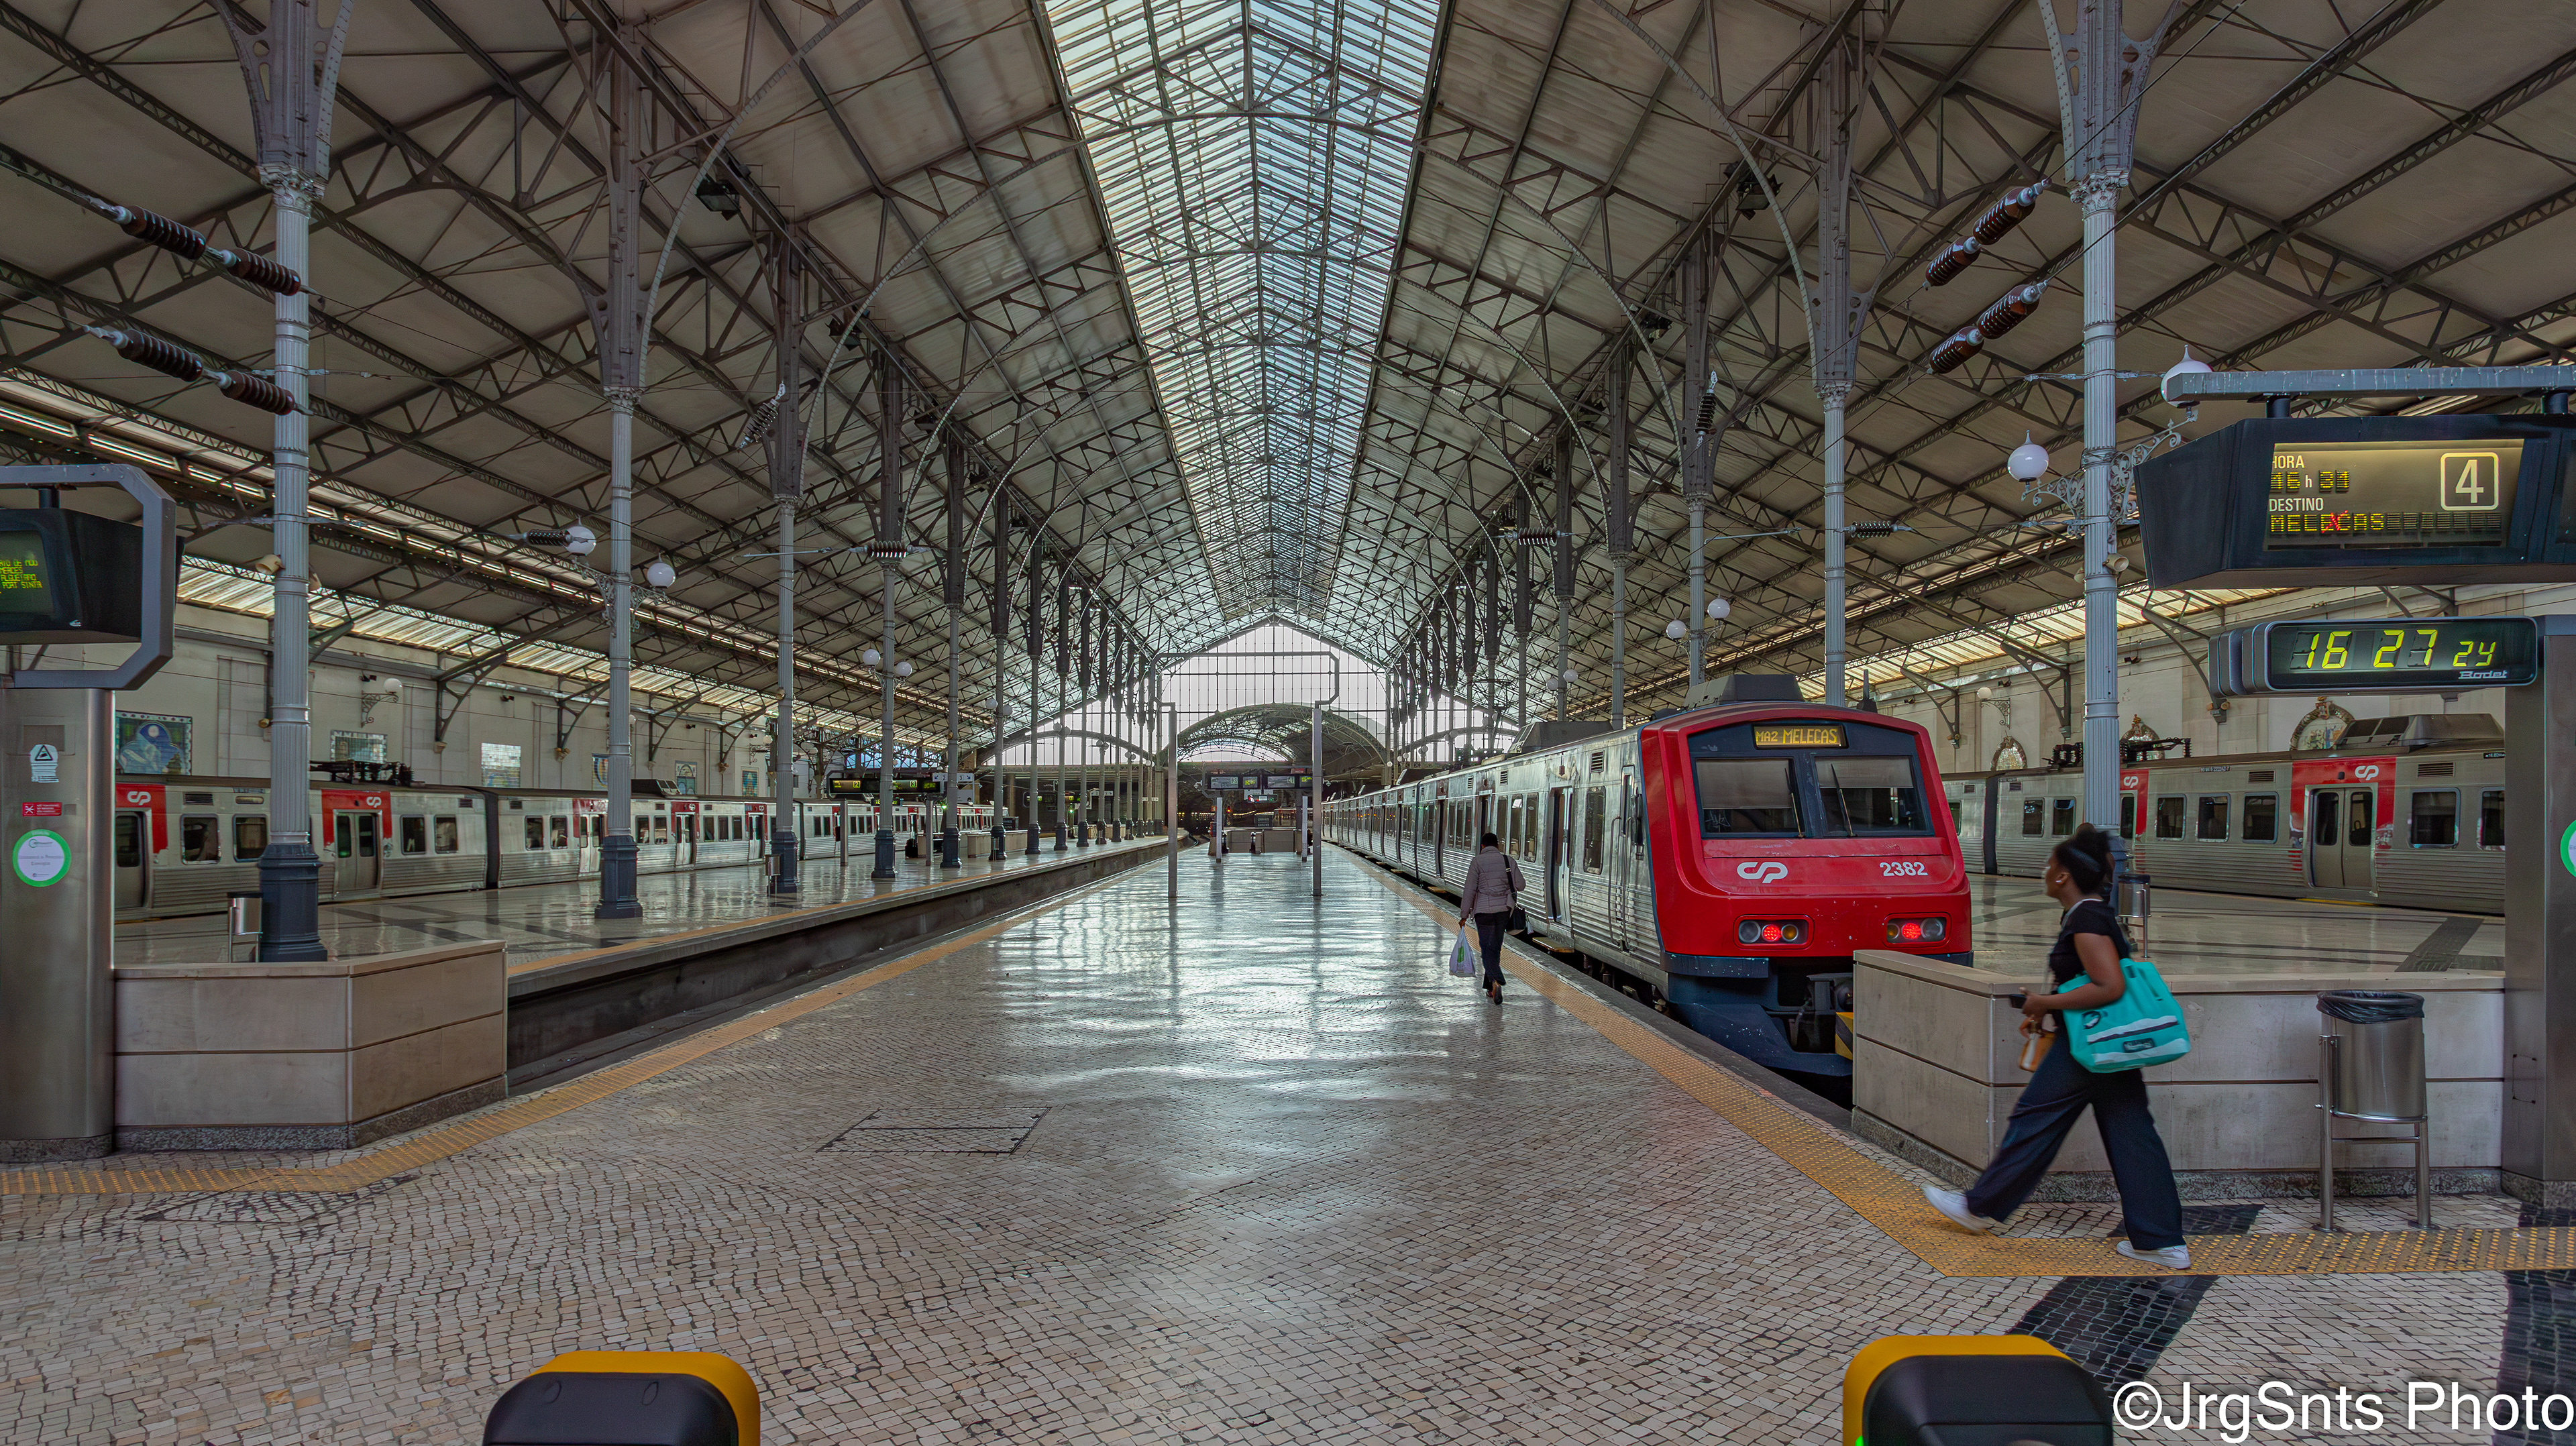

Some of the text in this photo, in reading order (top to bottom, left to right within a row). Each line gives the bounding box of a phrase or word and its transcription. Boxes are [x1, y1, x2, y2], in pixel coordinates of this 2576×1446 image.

[2272, 455, 2305, 469] HORA
[2271, 471, 2350, 490] 16 h 31
[2455, 459, 2484, 503] 4
[2269, 498, 2324, 512] DESTINO
[2271, 513, 2384, 532] MELECAS
[2306, 630, 2352, 669] 16
[2373, 629, 2438, 668] 27
[2458, 670, 2508, 679] Bodet
[1756, 728, 1837, 744] MA2 MELECAS
[1880, 861, 1929, 877] 2382
